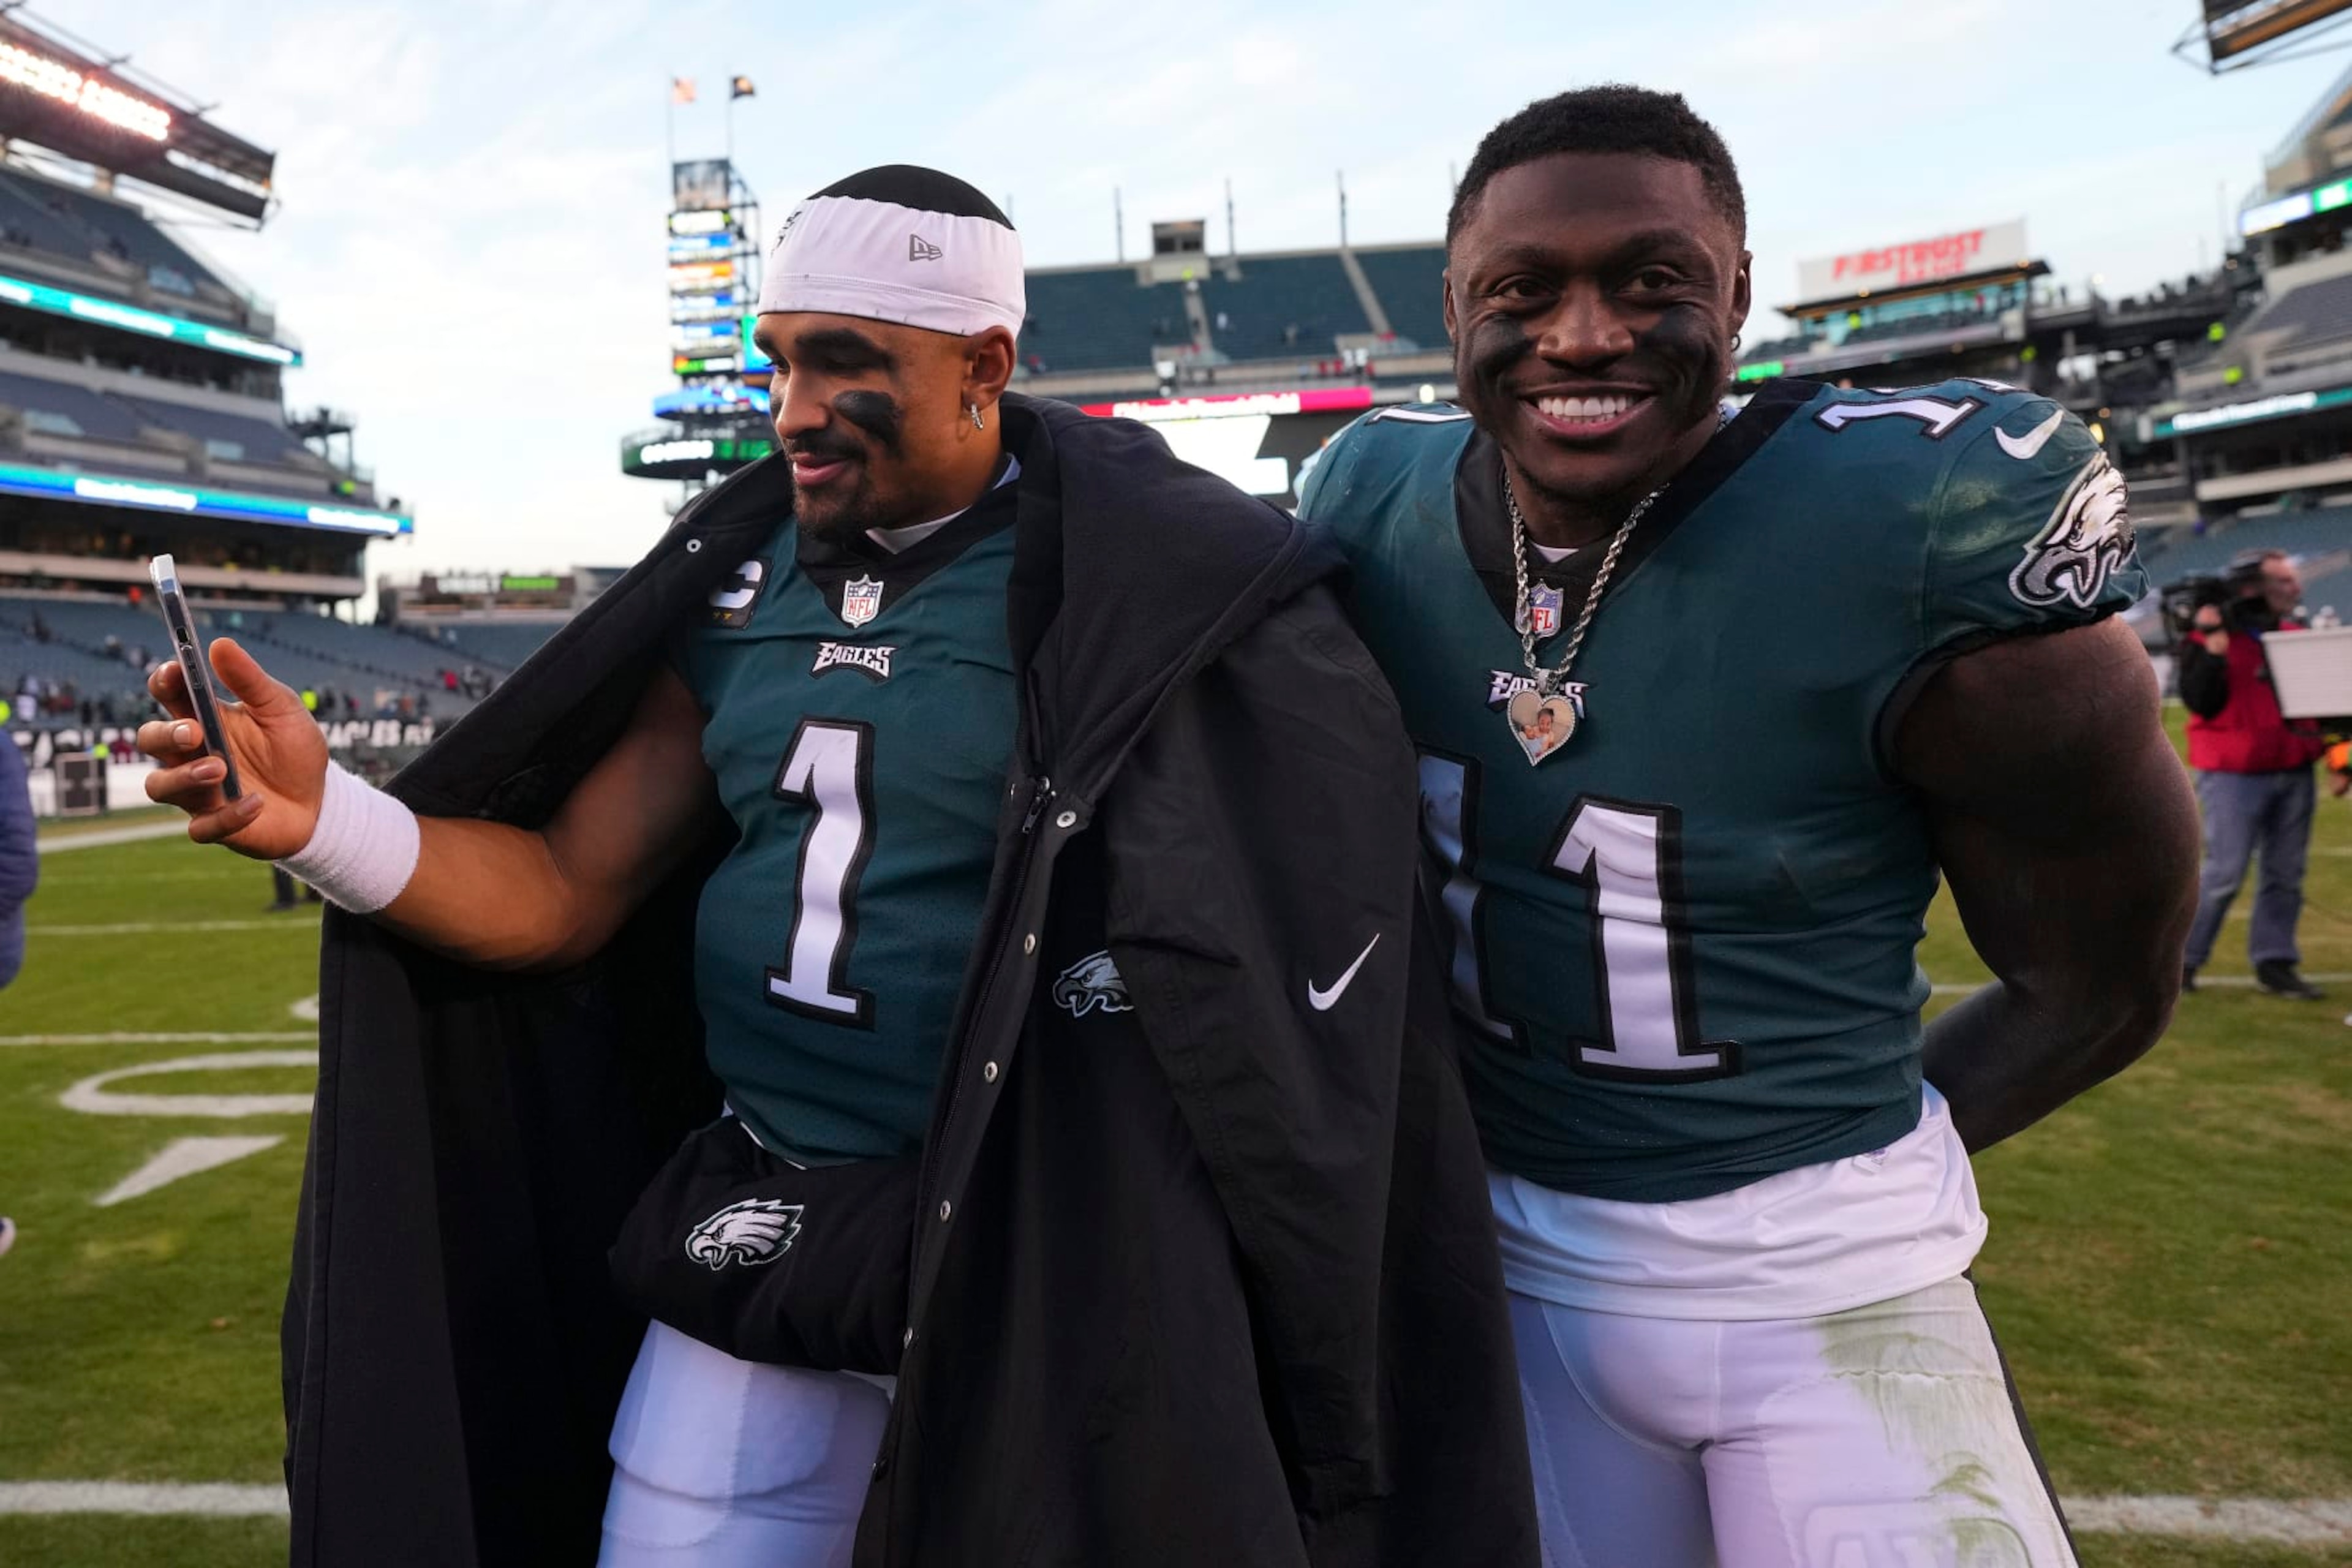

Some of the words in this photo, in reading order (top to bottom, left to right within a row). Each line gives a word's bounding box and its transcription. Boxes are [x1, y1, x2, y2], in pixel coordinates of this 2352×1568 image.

[848, 597, 873, 617] NFL
[812, 642, 897, 678] EAGLES
[1488, 669, 1591, 720] EAGS
[767, 719, 870, 1025] 1
